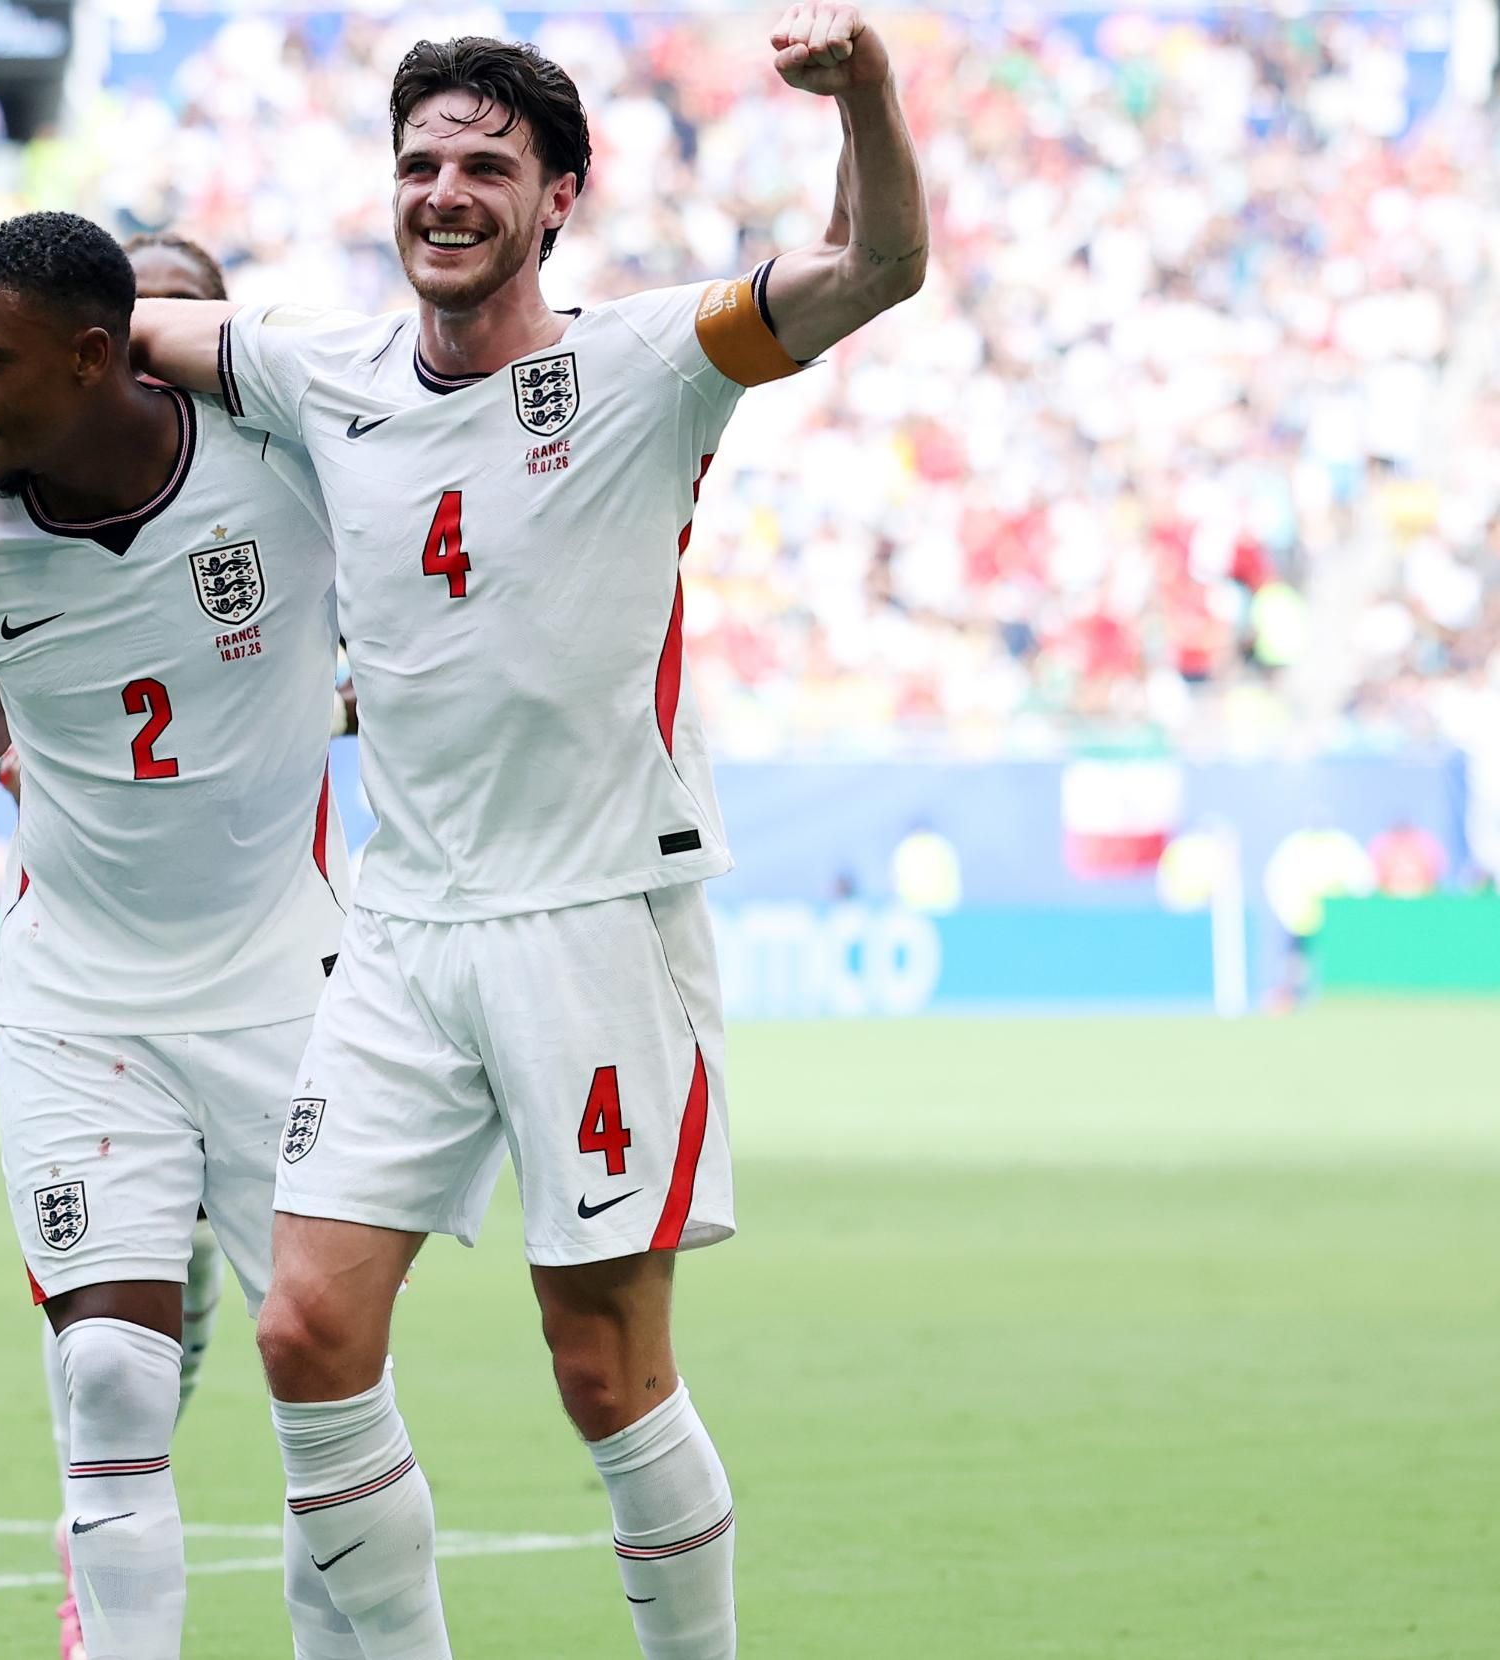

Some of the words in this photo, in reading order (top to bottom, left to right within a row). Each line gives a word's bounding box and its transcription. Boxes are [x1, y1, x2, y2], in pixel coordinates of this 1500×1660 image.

[526, 440, 570, 460] FRANCE
[528, 456, 568, 475] 18.07.26
[422, 491, 471, 598] 4
[215, 625, 261, 648] FRANCE
[220, 642, 262, 662] 18.07.26
[121, 678, 178, 780] 2
[710, 904, 943, 1018] mco
[578, 1066, 631, 1176] 4
